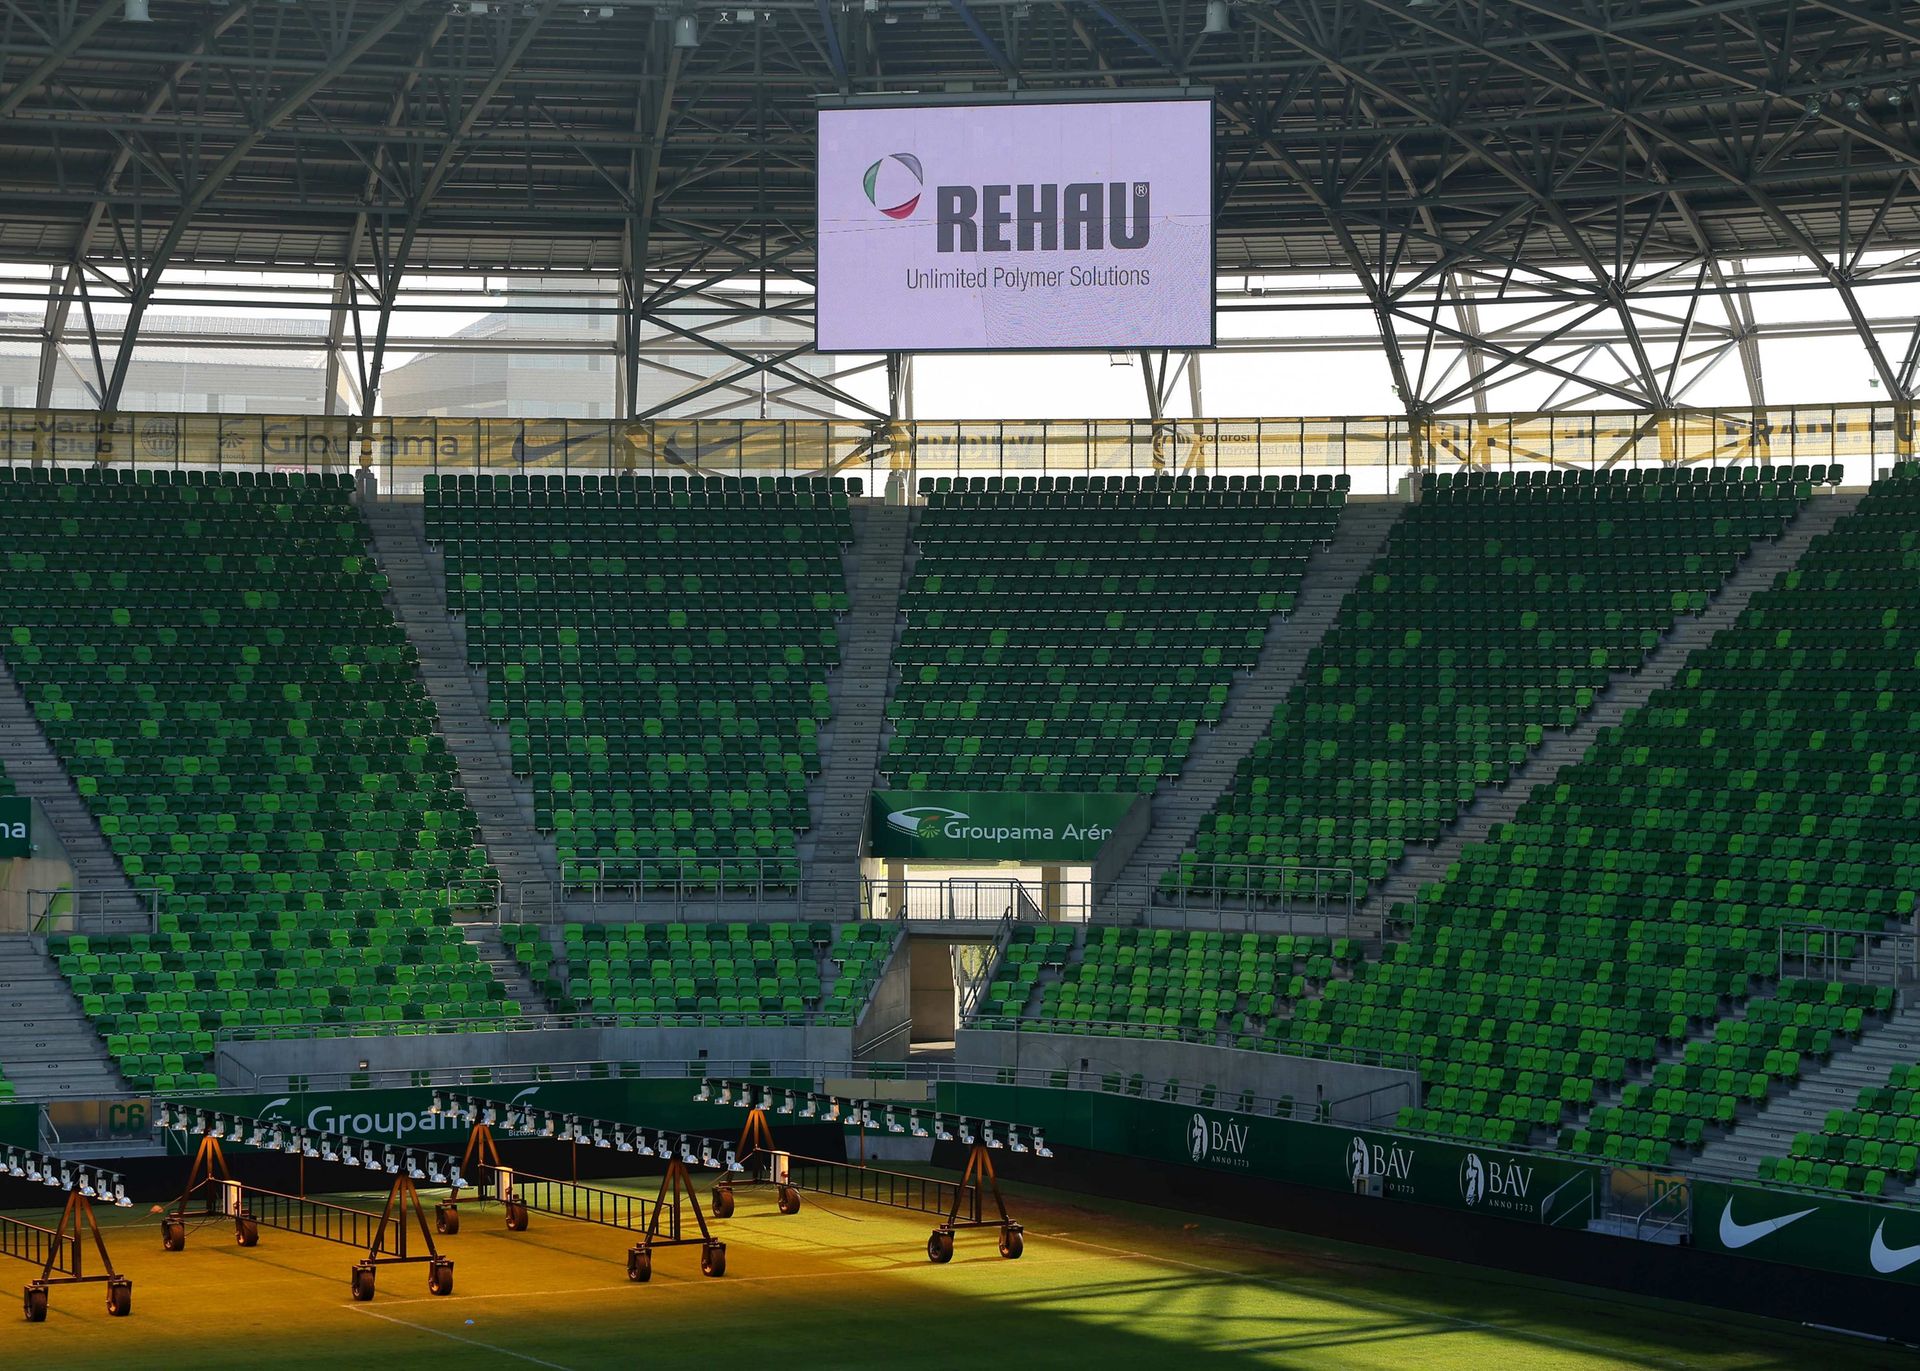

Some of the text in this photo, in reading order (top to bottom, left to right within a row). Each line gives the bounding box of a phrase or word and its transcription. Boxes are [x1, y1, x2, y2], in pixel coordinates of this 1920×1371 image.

[906, 264, 1151, 292] Unlimited Polymer Solutions
[943, 821, 1054, 843] Groupama
[109, 1102, 145, 1132] C6
[1211, 1117, 1250, 1155] BÁV
[1211, 1155, 1250, 1168] ANNO 1773
[1372, 1141, 1415, 1180] BÁV
[1397, 1184, 1416, 1194] 1773
[1489, 1158, 1534, 1199] BÁV
[1489, 1199, 1535, 1213] ANNO 1773
